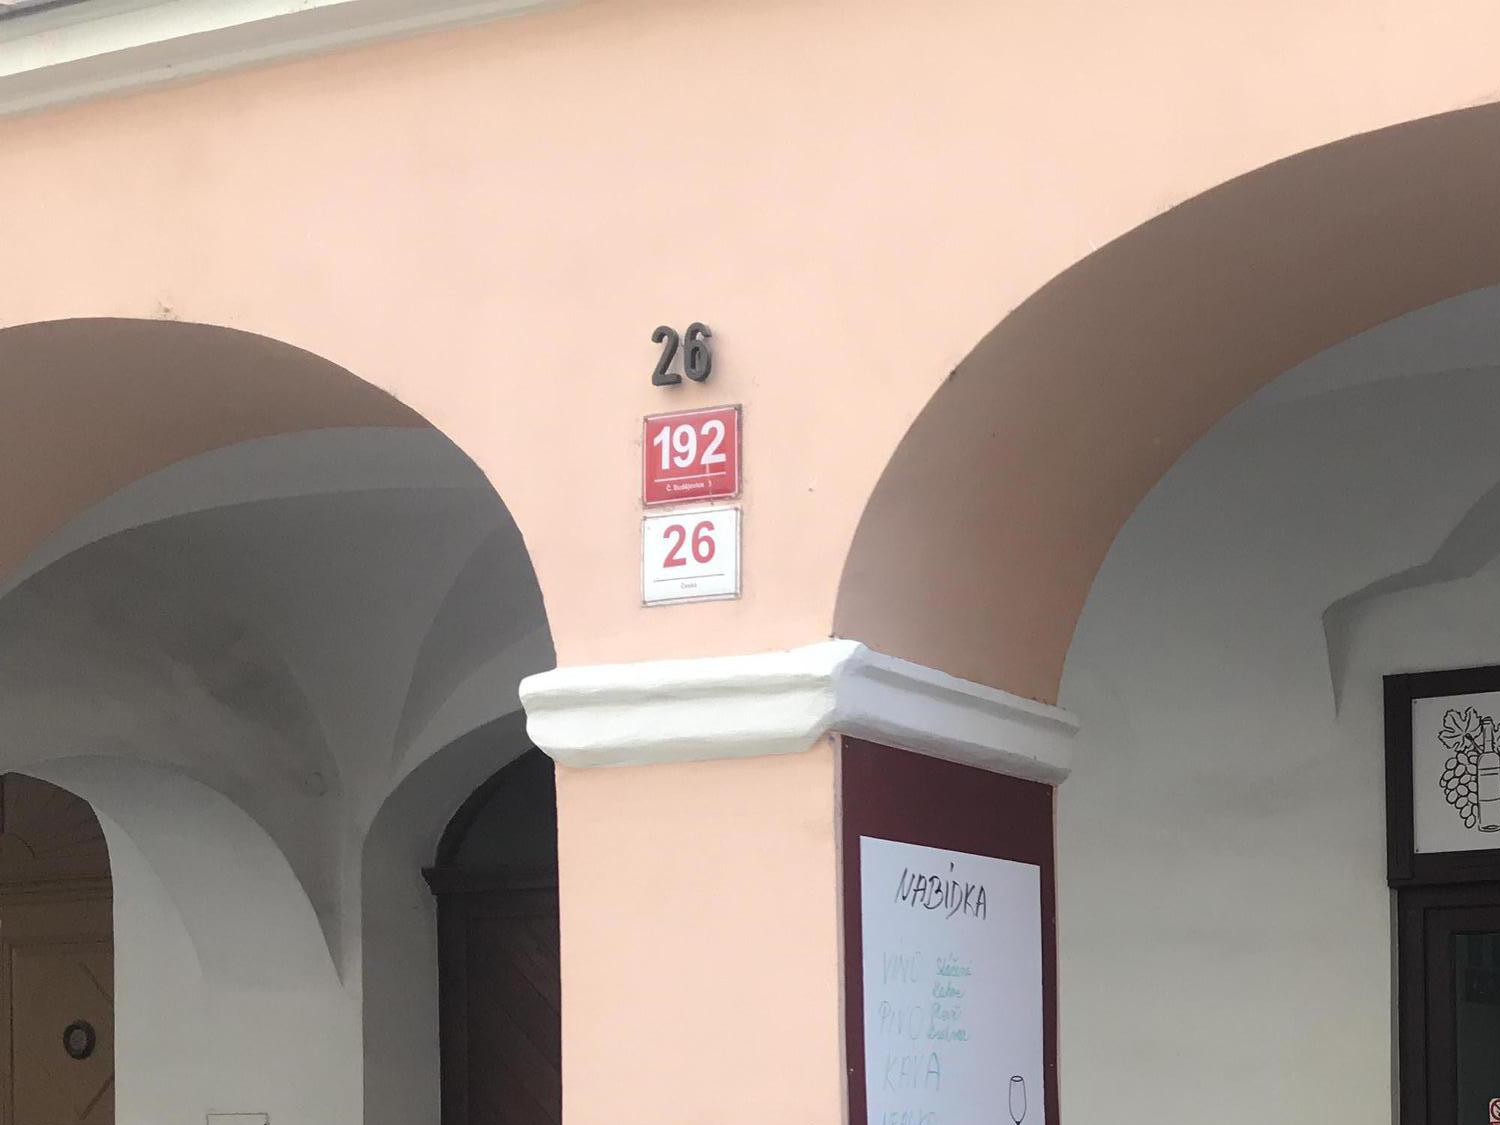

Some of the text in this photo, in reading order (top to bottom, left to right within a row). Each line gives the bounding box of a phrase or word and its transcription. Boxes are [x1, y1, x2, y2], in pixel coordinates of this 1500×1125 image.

[651, 322, 712, 386] 26
[653, 419, 727, 471] 192
[662, 520, 717, 569] 26
[894, 861, 987, 921] NABÍDKA
